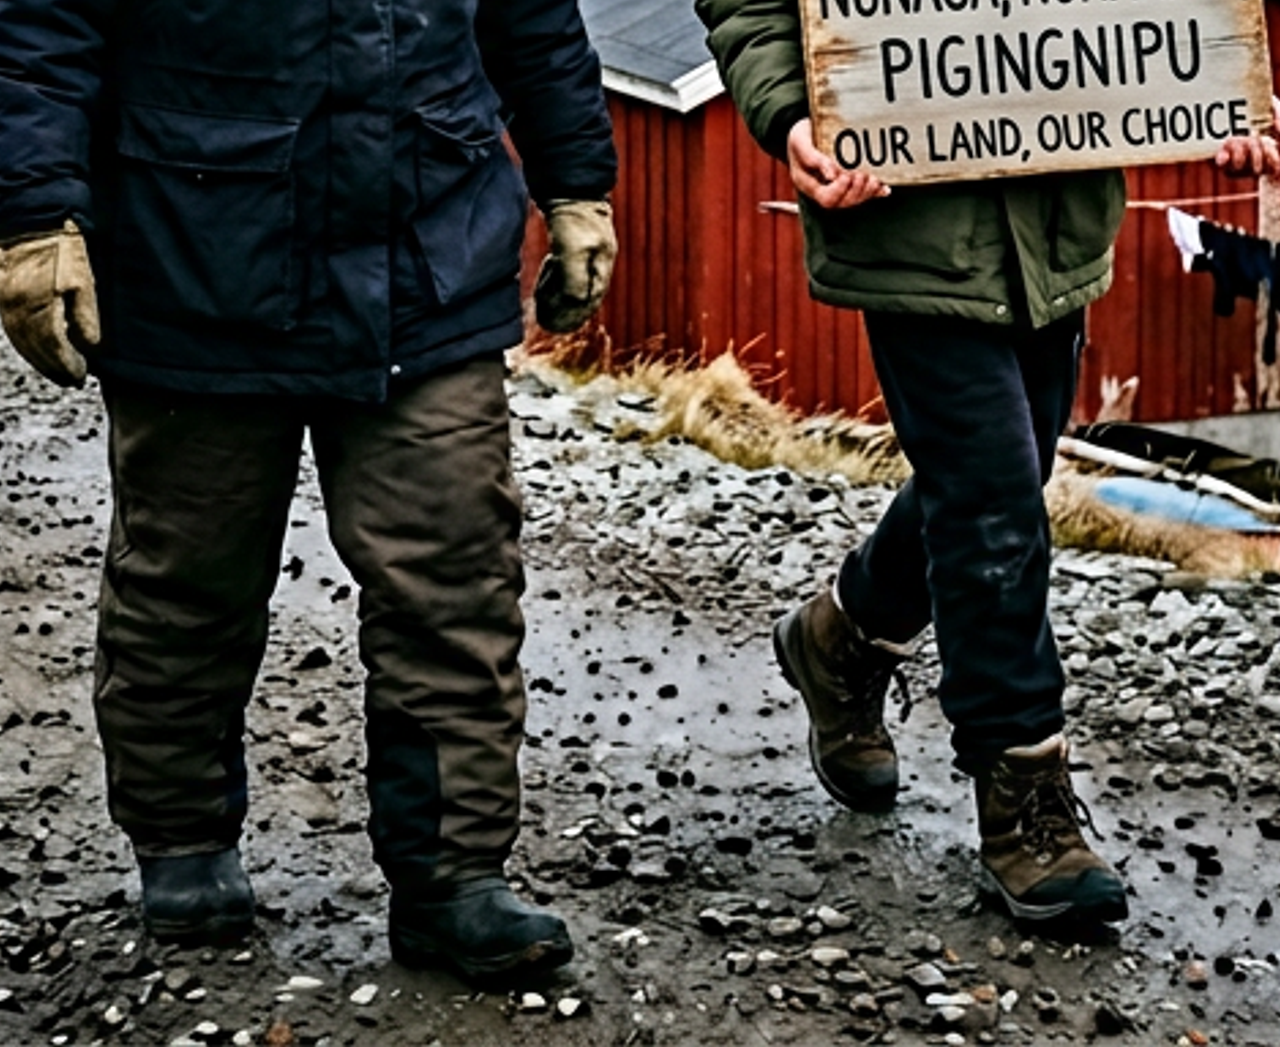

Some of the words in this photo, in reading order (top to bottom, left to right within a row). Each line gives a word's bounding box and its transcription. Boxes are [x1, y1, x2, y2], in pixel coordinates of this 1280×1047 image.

[880, 18, 1202, 103] PIGINGNIPU
[833, 125, 914, 171] OUR
[926, 117, 1032, 162] LAND,
[1037, 111, 1111, 153] OUR
[1121, 99, 1250, 146] CHOICE
